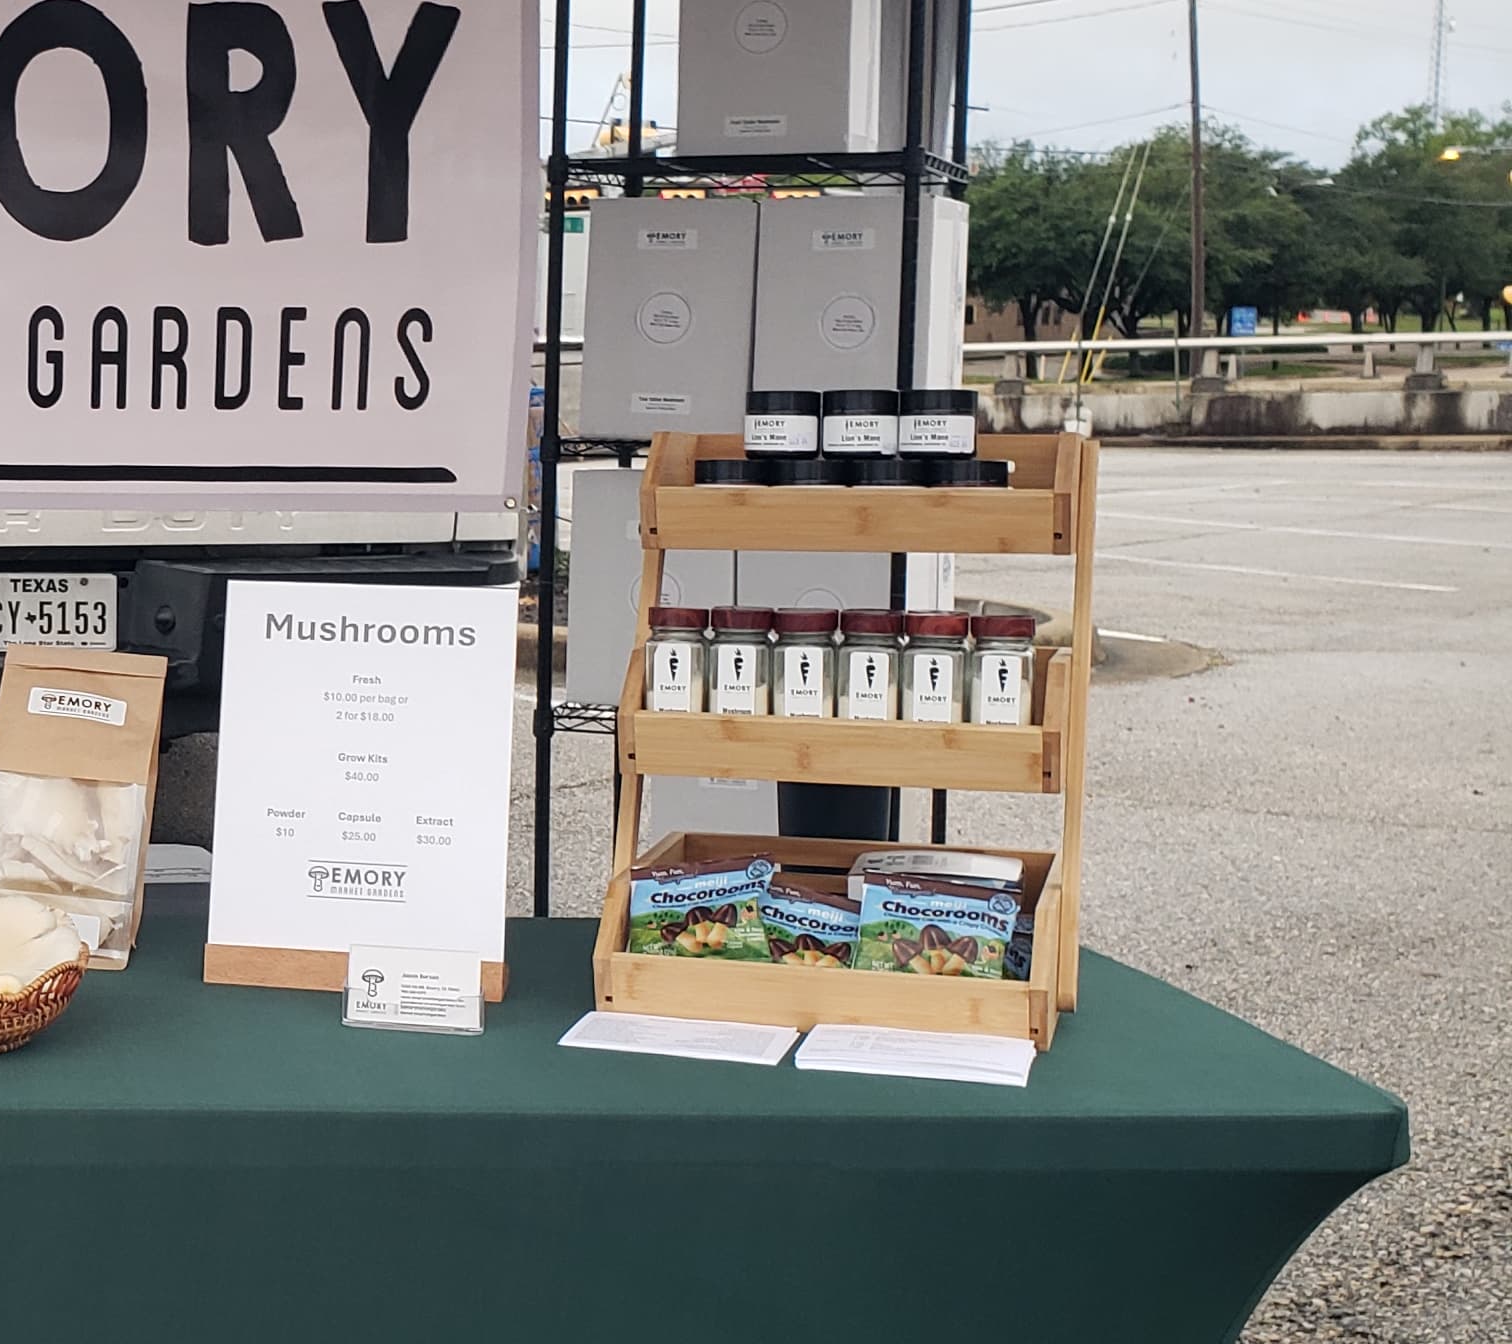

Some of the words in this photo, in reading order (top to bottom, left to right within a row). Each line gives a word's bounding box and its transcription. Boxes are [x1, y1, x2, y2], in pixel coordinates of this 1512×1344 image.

[27, 305, 433, 411] GARDENS
[10, 578, 69, 593] TEXAS
[39, 600, 107, 635] 5153
[265, 613, 477, 647] Mushrooms
[352, 674, 382, 685] Fresh
[58, 695, 112, 713] EMORY
[323, 691, 358, 703] $10.00
[359, 694, 376, 704] per
[378, 694, 397, 706] bag
[398, 696, 409, 705] or
[336, 711, 343, 720] 2
[345, 711, 359, 721] for
[360, 711, 395, 722] $18.00
[338, 752, 366, 763] Grow
[367, 753, 389, 764] Kits
[344, 771, 380, 782] $40.00
[266, 808, 306, 819] Powder
[338, 812, 382, 823] Capsule
[415, 816, 454, 827] Extract
[275, 827, 295, 838] $10
[341, 830, 377, 842] $25.00
[416, 834, 452, 846] $30.00
[331, 867, 406, 887] EMORY
[695, 876, 729, 889] meiji
[650, 879, 767, 905] Chocorooms
[761, 905, 859, 933] Chocoroo
[808, 908, 844, 922] meiji
[882, 900, 1010, 933] Chocorooms
